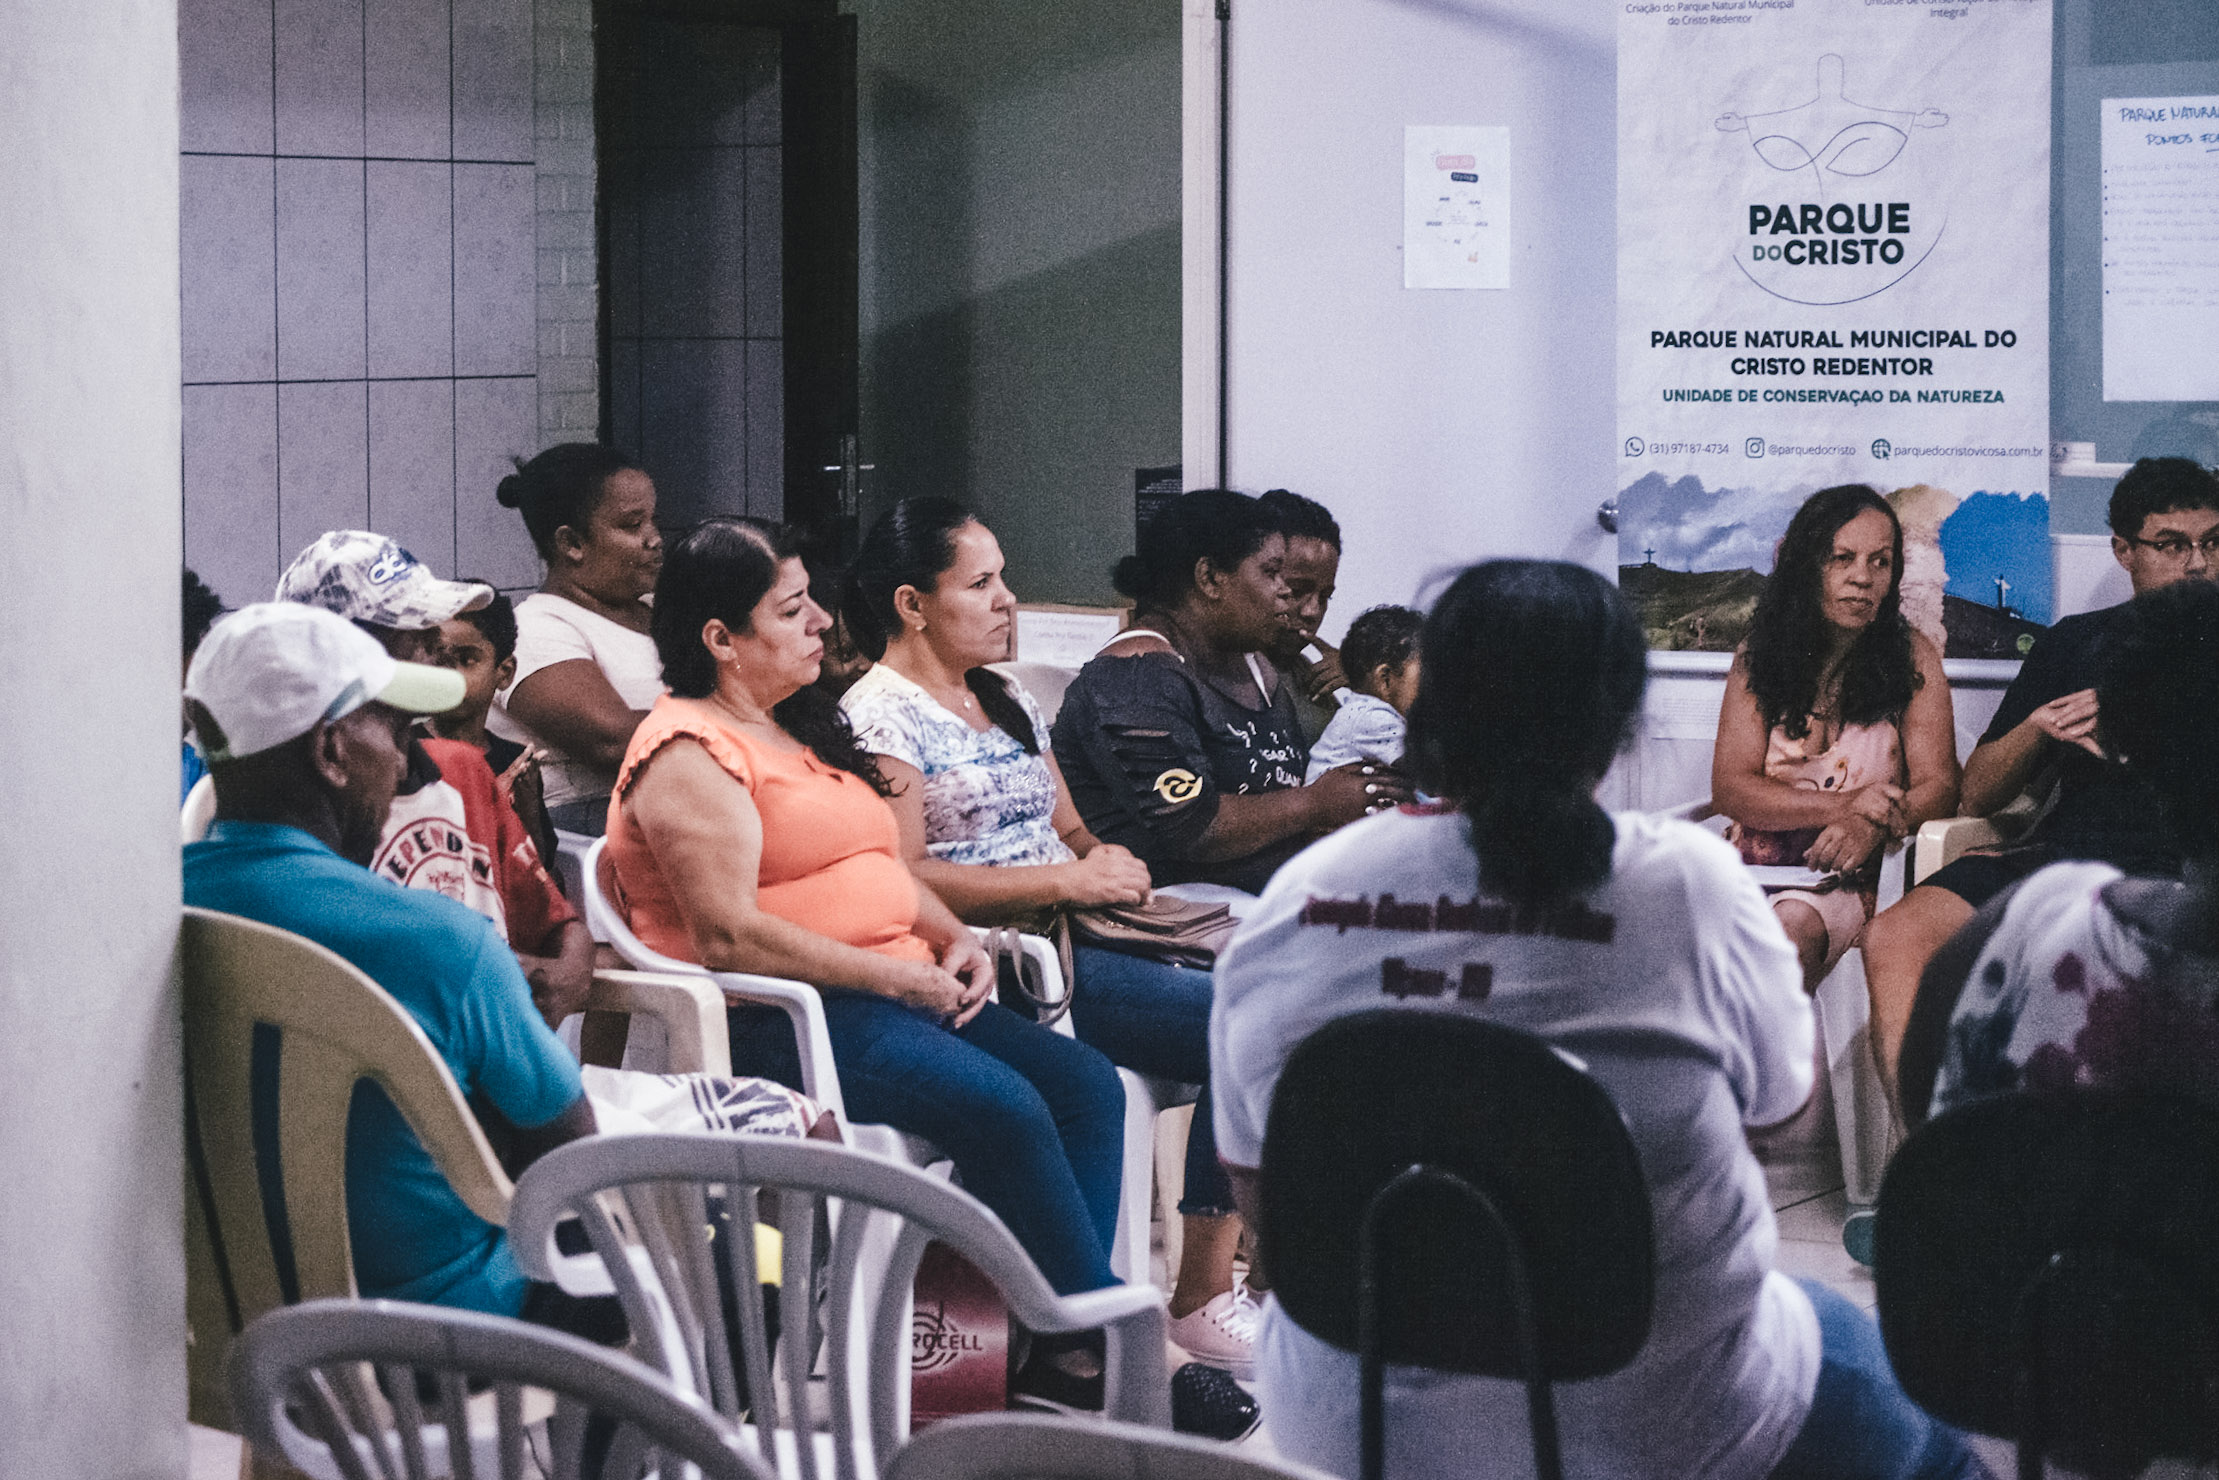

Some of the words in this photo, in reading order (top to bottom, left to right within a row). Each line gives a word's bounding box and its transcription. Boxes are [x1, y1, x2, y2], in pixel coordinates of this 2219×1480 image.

[1626, 3, 1660, 15] Criação
[1663, 3, 1675, 12] do
[1678, 2, 1710, 12] Parque
[1712, 0, 1746, 10] Natural
[1749, 0, 1795, 10] Municipal
[1930, 7, 1968, 20] Integral
[1668, 16, 1680, 25] do
[1682, 15, 1709, 25] Cristo
[1711, 14, 1752, 24] Redentor
[2119, 108, 2167, 122] PARQUE
[2170, 106, 2219, 120] NATURA
[1750, 203, 1909, 235] PARQUE
[1651, 330, 1737, 348] PARQUE
[1745, 330, 1843, 348] NATURAL
[1851, 330, 1978, 348] MUNICIPAL
[1984, 330, 2017, 348] DO
[1731, 358, 1806, 375] CRISTO
[1813, 358, 1933, 375] REDENTOR
[1663, 389, 1732, 402] UNIDADE
[1738, 389, 1758, 402] DE
[1889, 389, 1912, 403] DA
[1917, 389, 2005, 403] NATUREZA
[1671, 442, 1730, 455] 97187-4734
[1768, 444, 1856, 456] @parquedocristo
[1894, 445, 2043, 458] parquedocristovicosa.com.br
